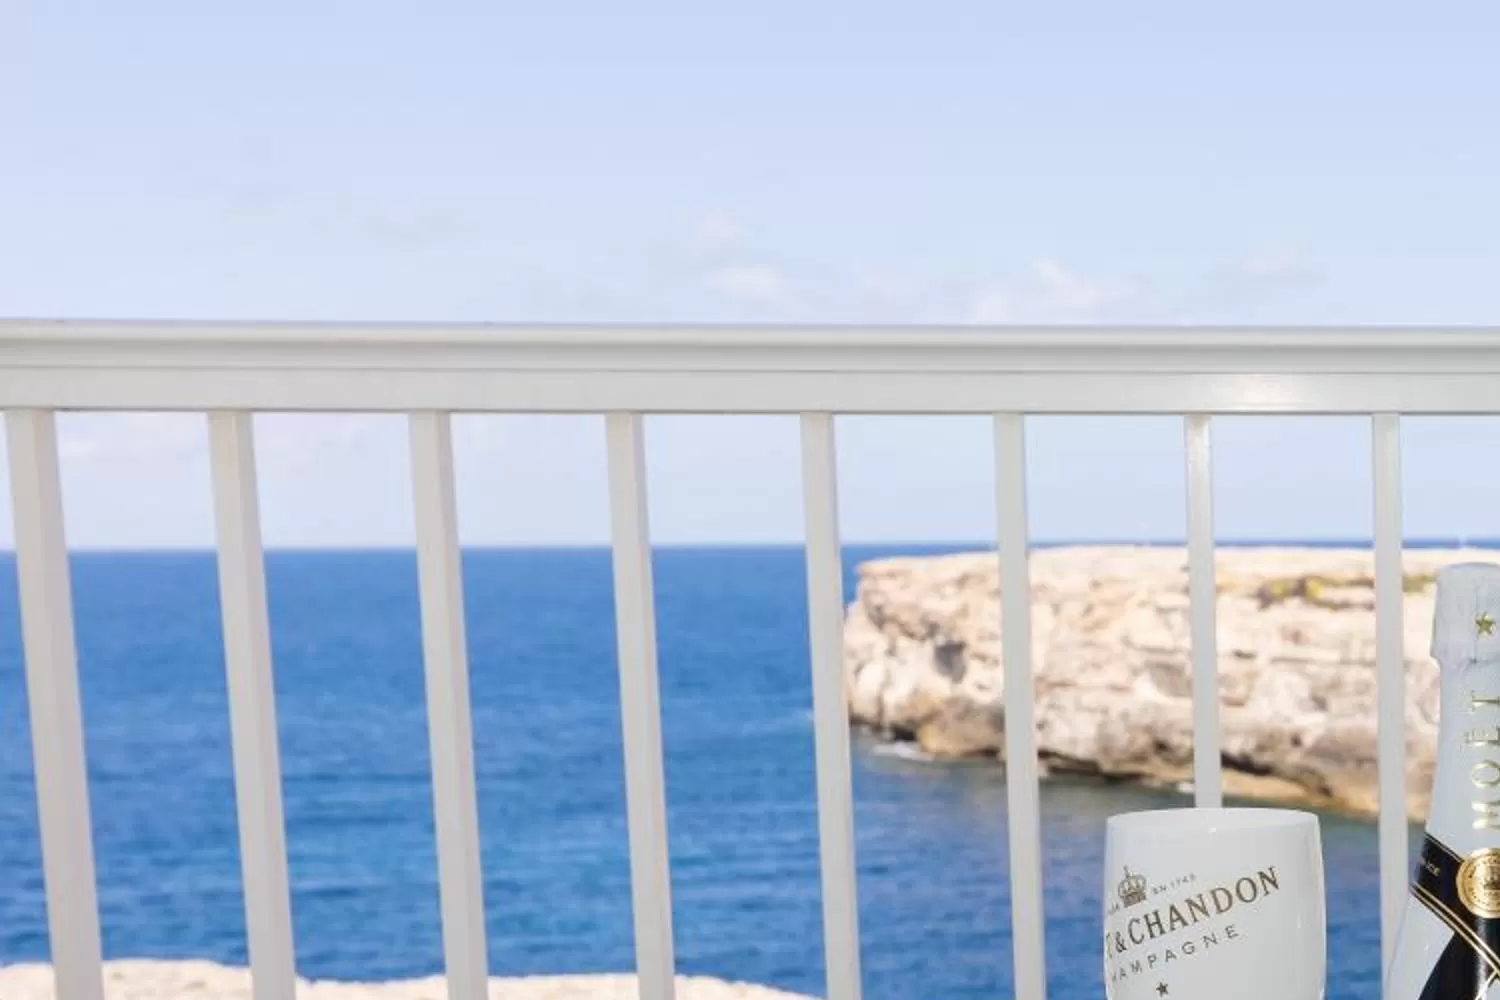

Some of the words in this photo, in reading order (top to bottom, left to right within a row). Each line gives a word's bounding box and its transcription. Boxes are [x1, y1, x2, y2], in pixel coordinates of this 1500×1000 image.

[1115, 931, 1128, 954] &
[1127, 865, 1280, 946] CHANDON
[1111, 924, 1240, 983] AMPAGNE
